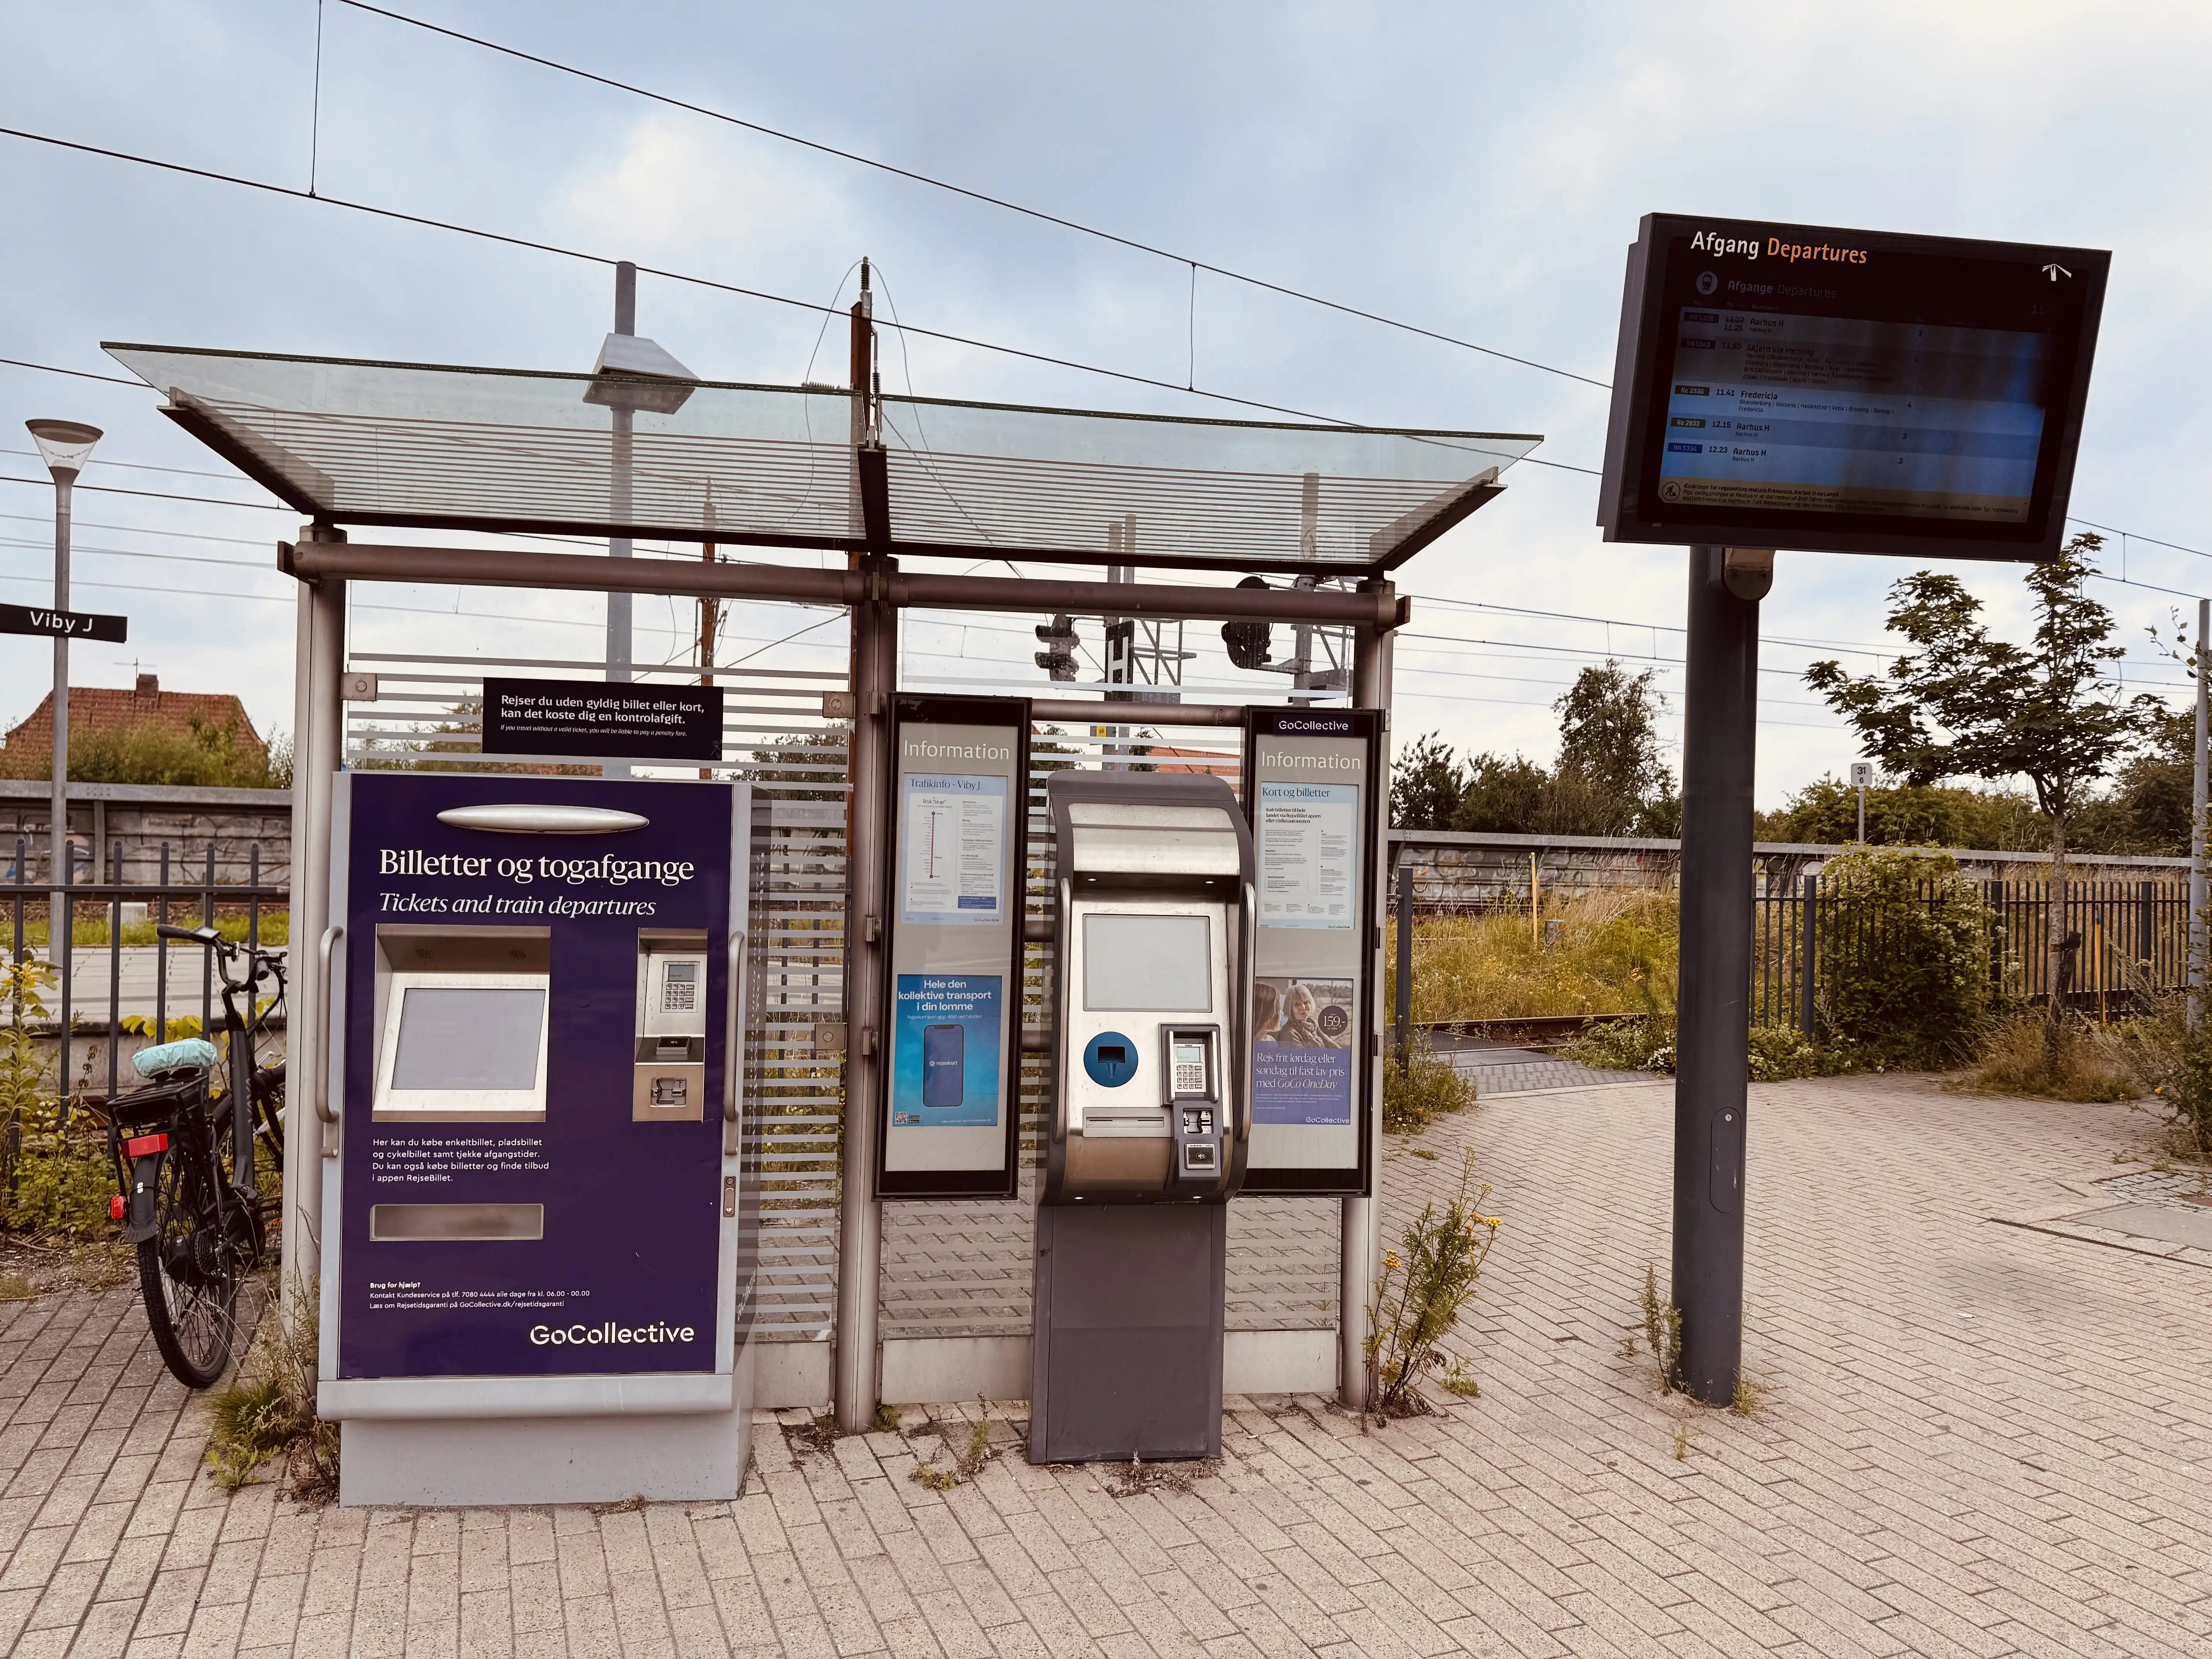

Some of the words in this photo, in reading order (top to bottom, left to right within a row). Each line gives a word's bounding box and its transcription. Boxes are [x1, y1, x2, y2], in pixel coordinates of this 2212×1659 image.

[1691, 232, 1759, 259] Afgang
[1768, 238, 1867, 263] Departures
[1728, 280, 1772, 294] Afgange
[1778, 284, 1836, 298] Departures
[1750, 318, 1777, 326] Aarhus
[1741, 391, 1778, 400] Fredericia
[30, 611, 76, 633] Viby
[83, 618, 92, 632] J
[1108, 636, 1128, 692] H
[502, 696, 535, 706] Rejser
[539, 696, 552, 706] du
[556, 697, 582, 707] uden
[587, 699, 619, 710] gyldig
[623, 699, 650, 709] billet
[653, 701, 677, 710] eller
[680, 702, 704, 713] kort,
[501, 708, 520, 718] kan
[524, 709, 542, 718] det
[546, 709, 575, 720] koste
[579, 711, 595, 722] dig
[615, 712, 685, 725] kontrolafgift.
[1279, 721, 1348, 730] GoCollective
[905, 740, 1008, 759] Information
[1262, 751, 1360, 769] Information
[910, 779, 950, 788] Trafikinfo
[958, 780, 976, 791] Viby
[1263, 788, 1281, 796] Kort
[1284, 790, 1295, 799] og
[1297, 788, 1330, 797] billetter
[380, 850, 491, 876] Billetter
[498, 859, 533, 883] og
[538, 854, 694, 886] togafgange
[380, 893, 448, 912] Tickets
[452, 895, 493, 912] and
[496, 896, 544, 913] train
[549, 896, 656, 918] departures
[924, 980, 946, 988] Hele
[948, 980, 966, 988] den
[899, 991, 944, 1000] kollektive
[946, 991, 991, 1001] transport
[917, 1002, 919, 1010] i
[922, 1002, 937, 1010] din
[939, 1002, 973, 1010] lomme
[1324, 1016, 1345, 1027] 159,-
[1257, 1053, 1274, 1063] Rejs
[1276, 1053, 1288, 1062] frit
[1290, 1053, 1317, 1065] lørdag
[1318, 1054, 1336, 1063] eller
[1256, 1066, 1287, 1077] søndag
[1299, 1066, 1314, 1075] fast
[1316, 1067, 1328, 1075] lav
[1329, 1068, 1345, 1077] pris
[1256, 1079, 1276, 1088] med
[1278, 1079, 1301, 1088] GoCo
[1303, 1079, 1338, 1089] OneDay
[446, 1139, 495, 1147] enkeltbillet,
[499, 1139, 542, 1147] pladsbillet
[387, 1150, 430, 1159] cykelbillet
[457, 1150, 481, 1159] tjekke
[484, 1150, 539, 1159] afgangstider.
[404, 1162, 424, 1171] også
[407, 1174, 452, 1183] RejseBillet.
[531, 1321, 694, 1345] GoCollective
